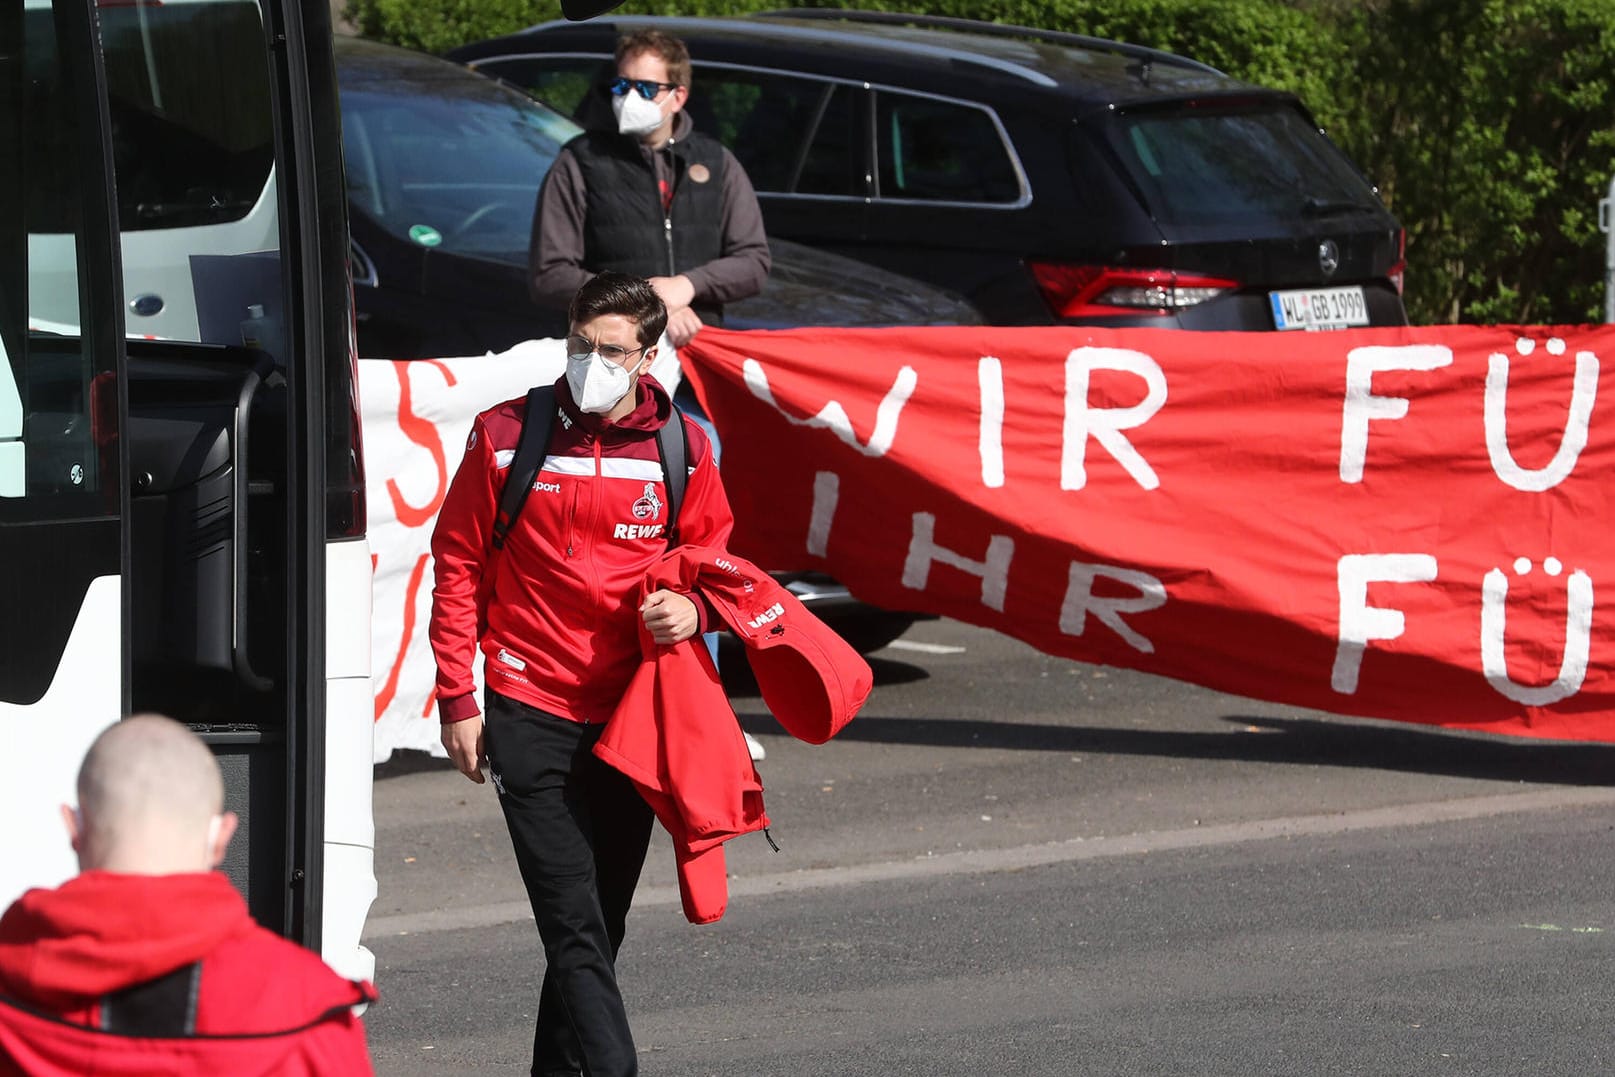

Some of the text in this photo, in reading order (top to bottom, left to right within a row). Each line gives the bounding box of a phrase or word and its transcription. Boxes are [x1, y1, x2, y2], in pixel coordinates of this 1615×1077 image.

[1282, 291, 1363, 323] WL GB 1999
[742, 337, 1600, 492] WIR FÜ
[806, 471, 1595, 706] IHR FÜ
